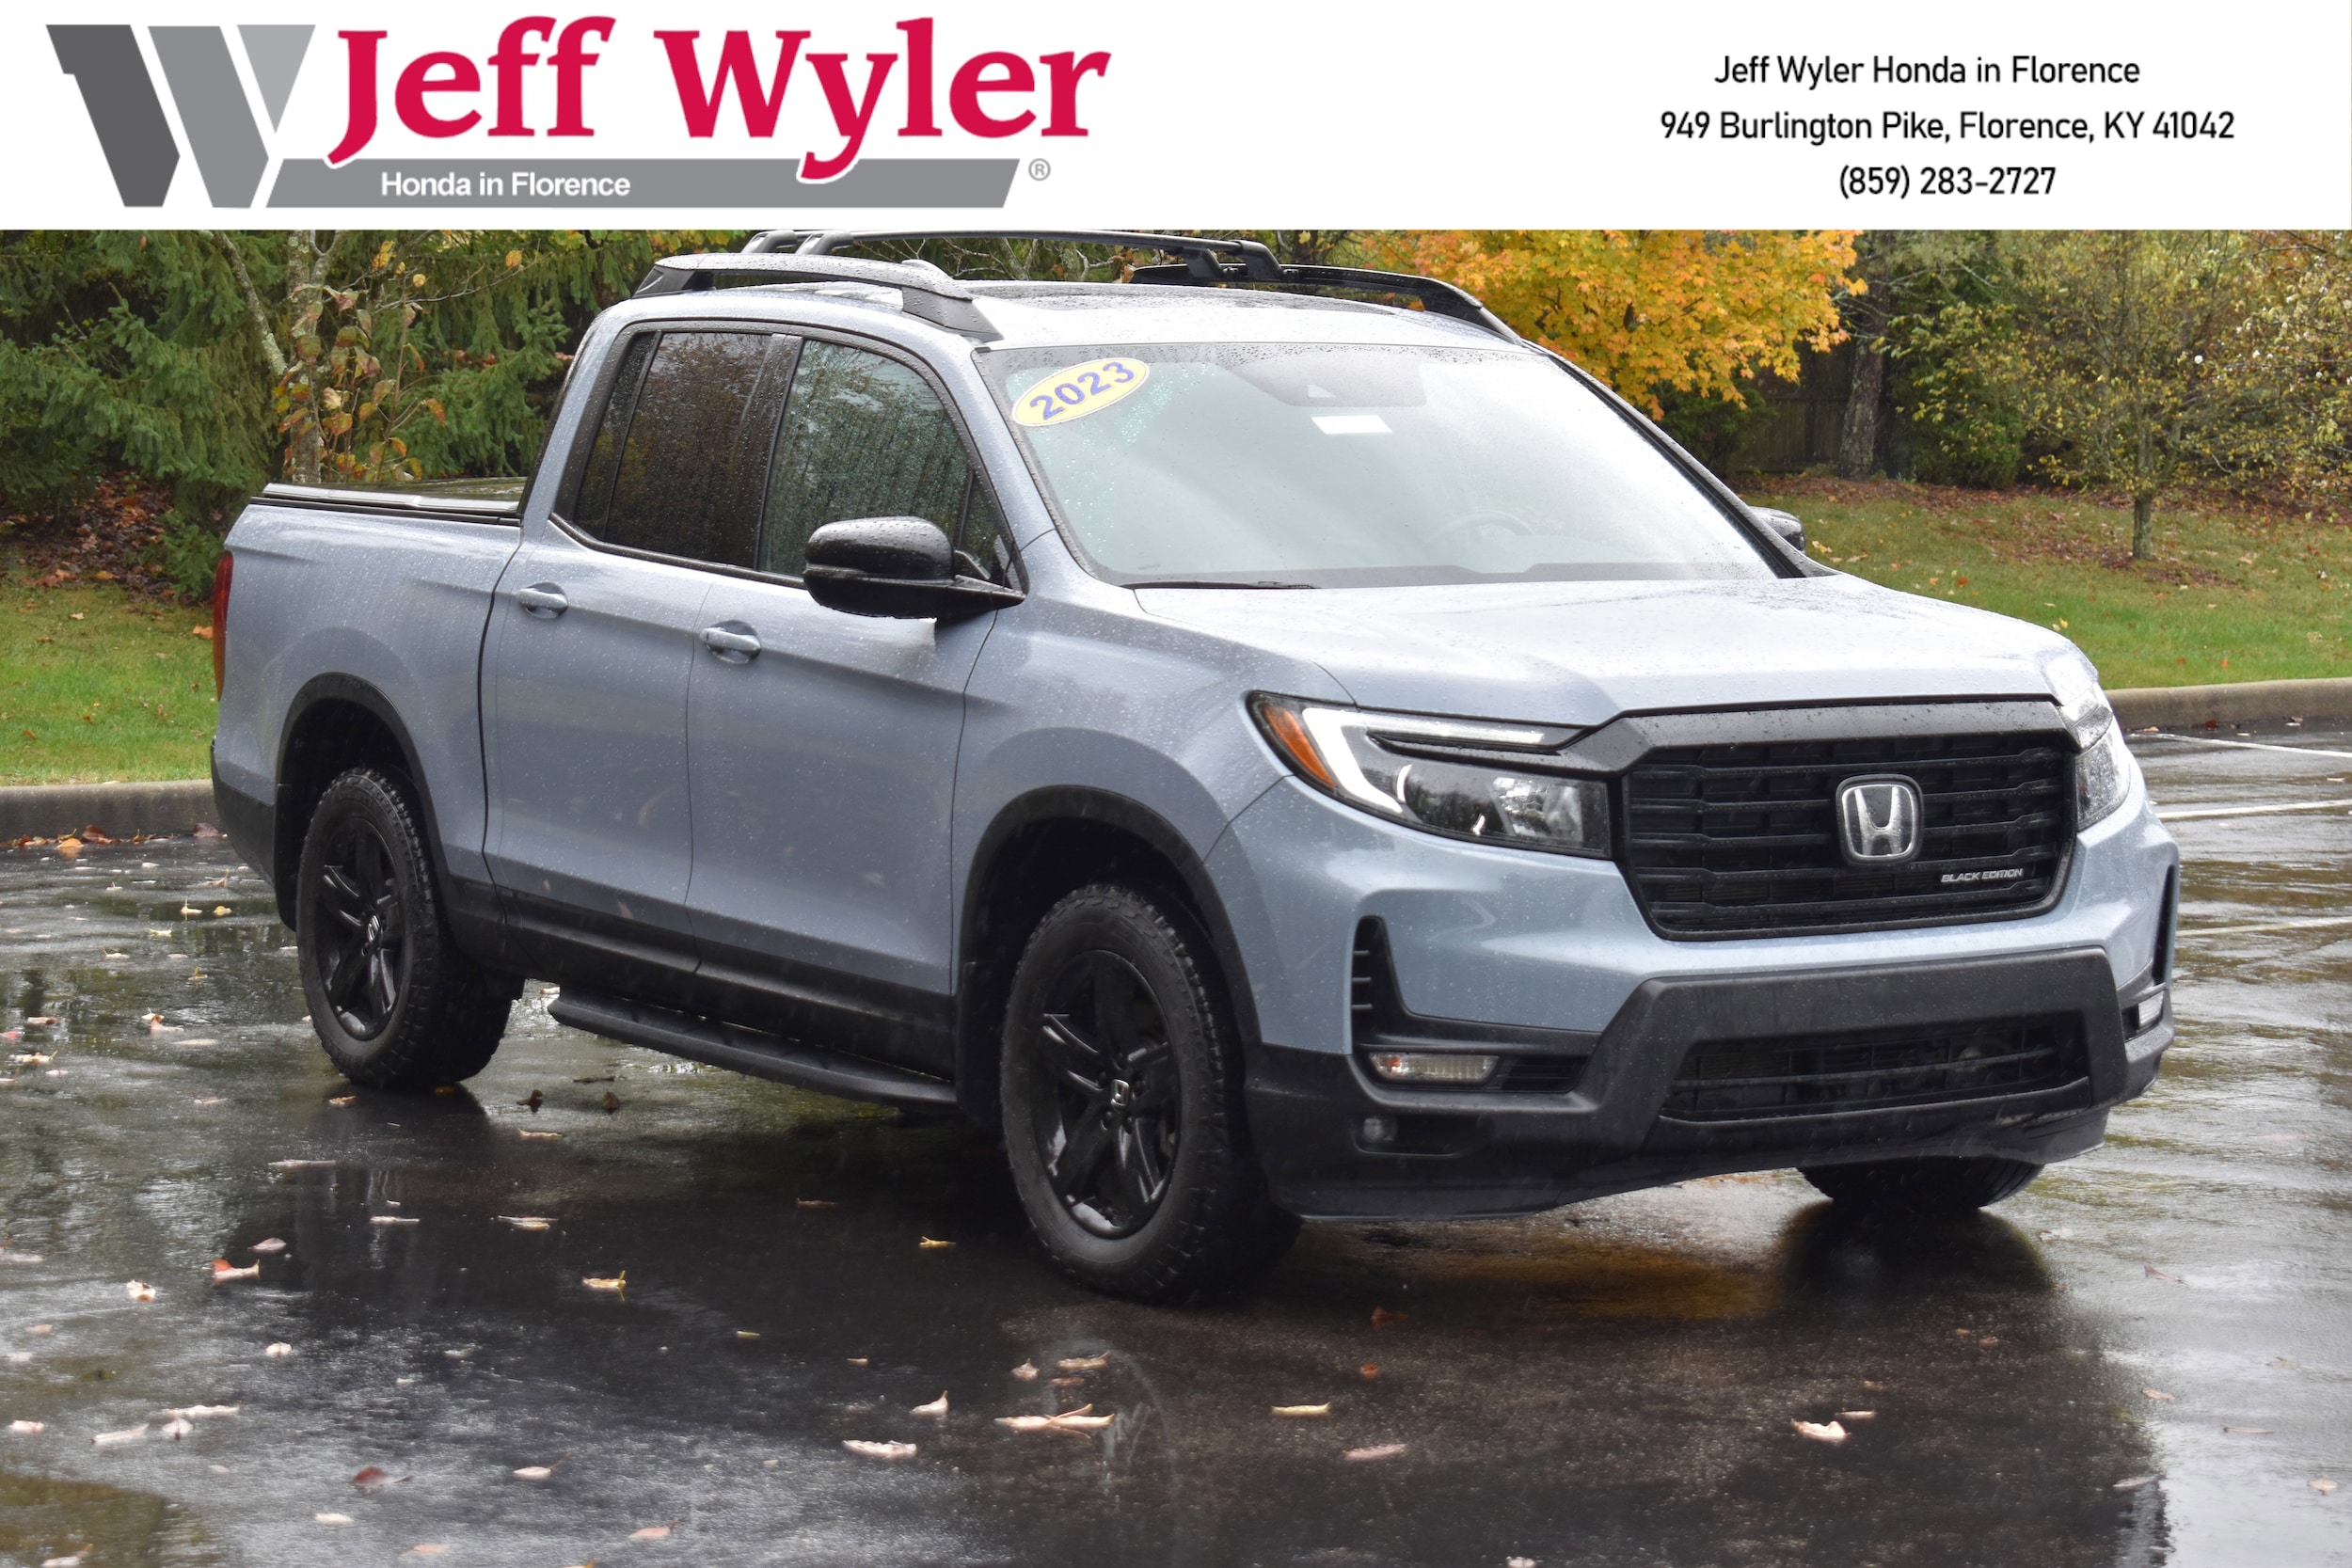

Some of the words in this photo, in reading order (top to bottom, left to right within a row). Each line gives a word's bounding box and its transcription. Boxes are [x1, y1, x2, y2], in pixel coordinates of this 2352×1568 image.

[1029, 361, 1135, 420] 2023
[1940, 871, 1980, 883] BLACK
[1981, 867, 2024, 879] EDITION
